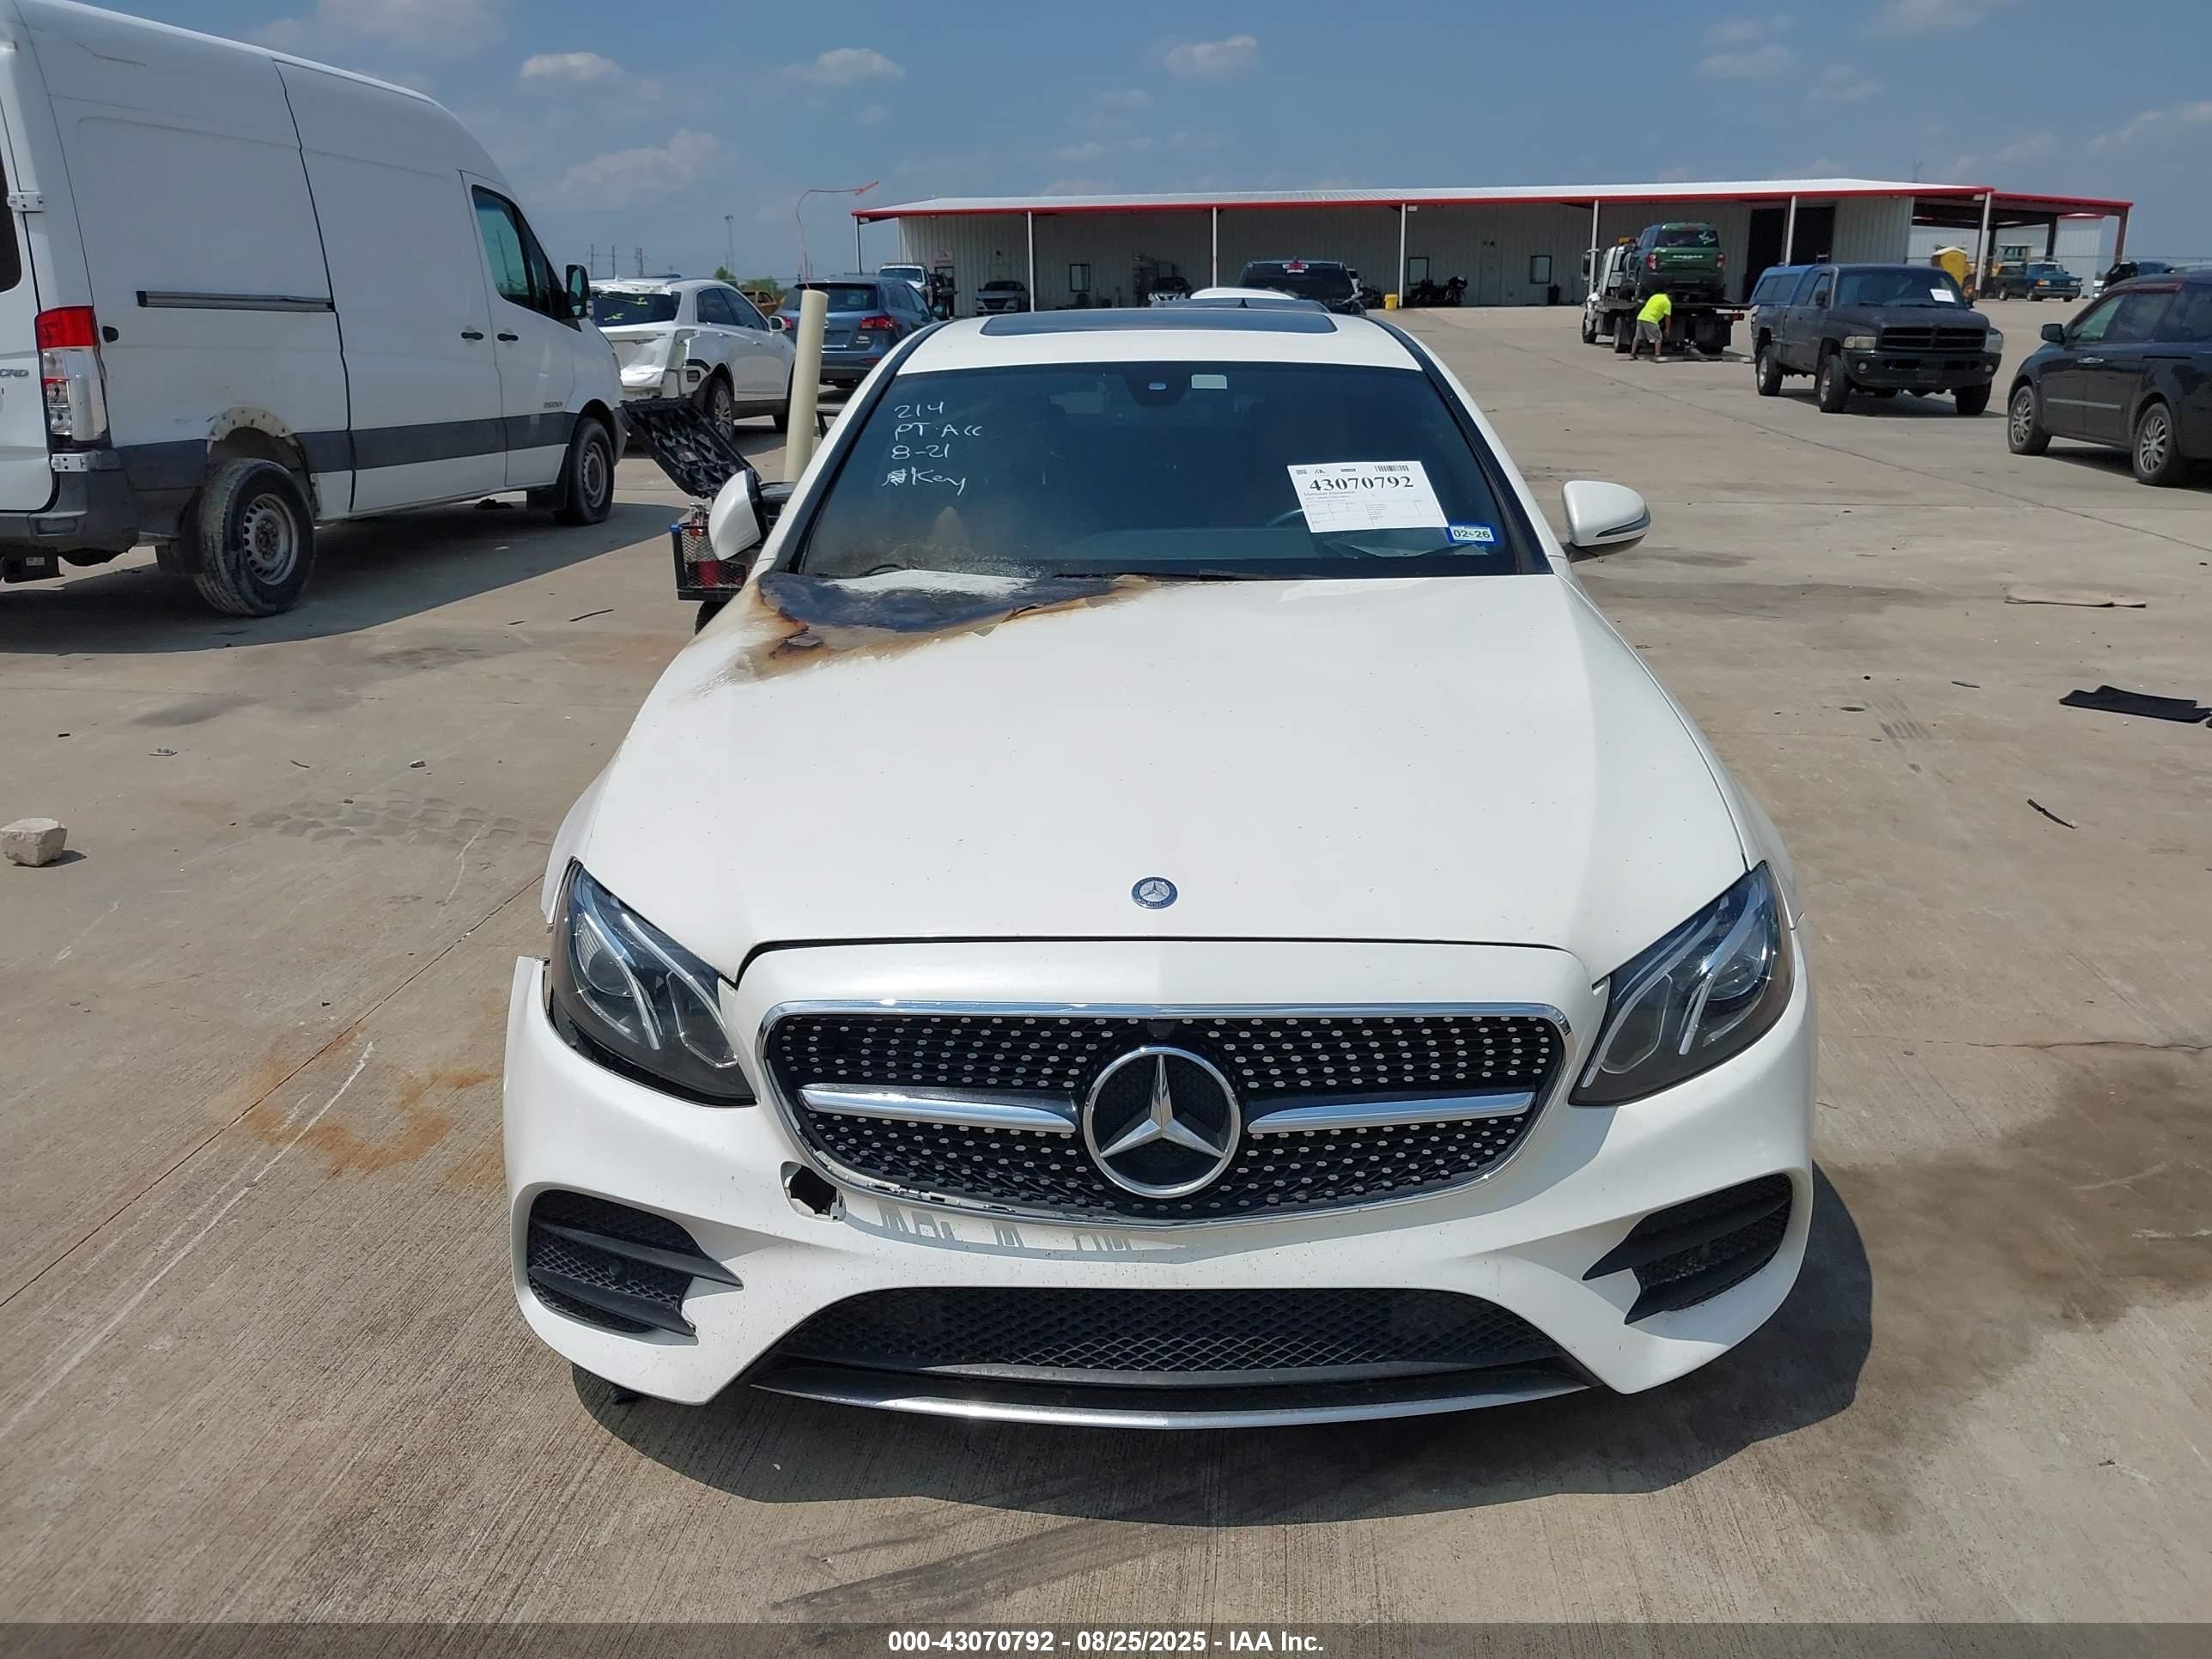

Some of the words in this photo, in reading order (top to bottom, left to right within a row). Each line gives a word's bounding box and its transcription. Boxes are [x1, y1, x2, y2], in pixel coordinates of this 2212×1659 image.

[894, 401, 945, 419] 214
[890, 443, 950, 460] 8-21
[1309, 476, 1414, 491] 43070792
